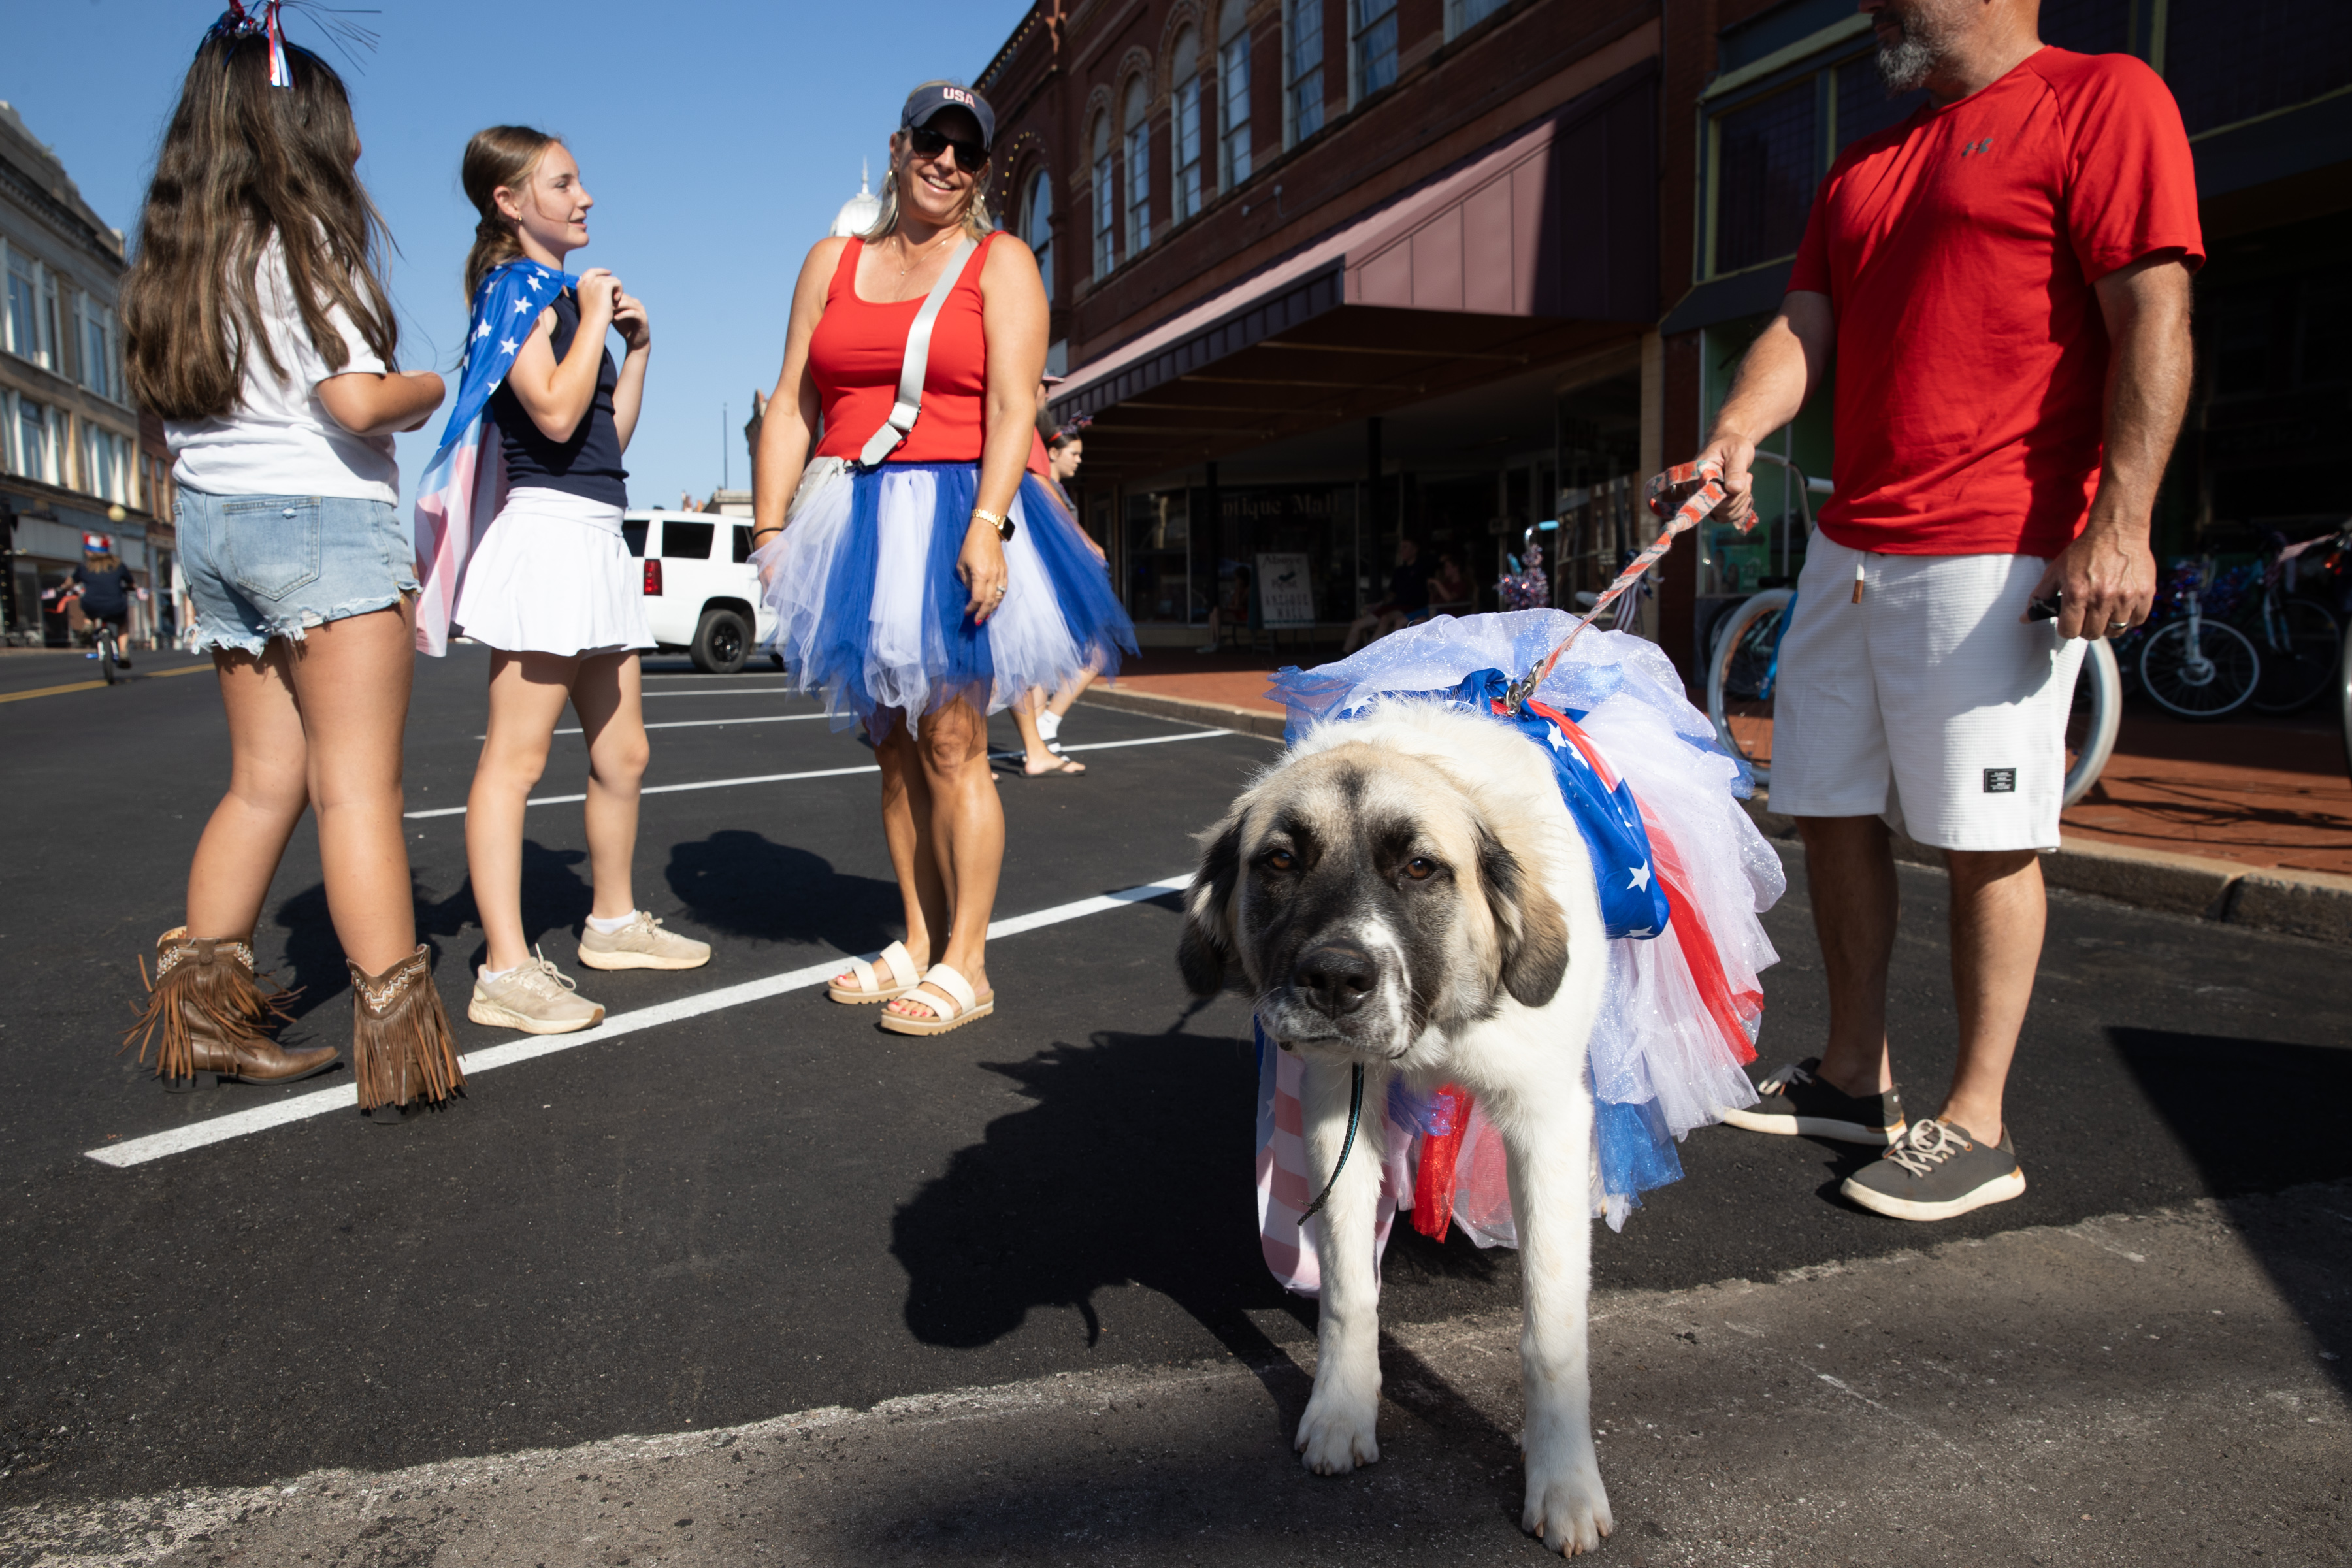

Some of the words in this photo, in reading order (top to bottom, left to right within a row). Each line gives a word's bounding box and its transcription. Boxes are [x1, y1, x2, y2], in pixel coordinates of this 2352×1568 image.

[943, 87, 975, 108] USA
[1223, 497, 1281, 520] ntique
[1290, 492, 1339, 515] Mall
[1262, 555, 1301, 569] Above
